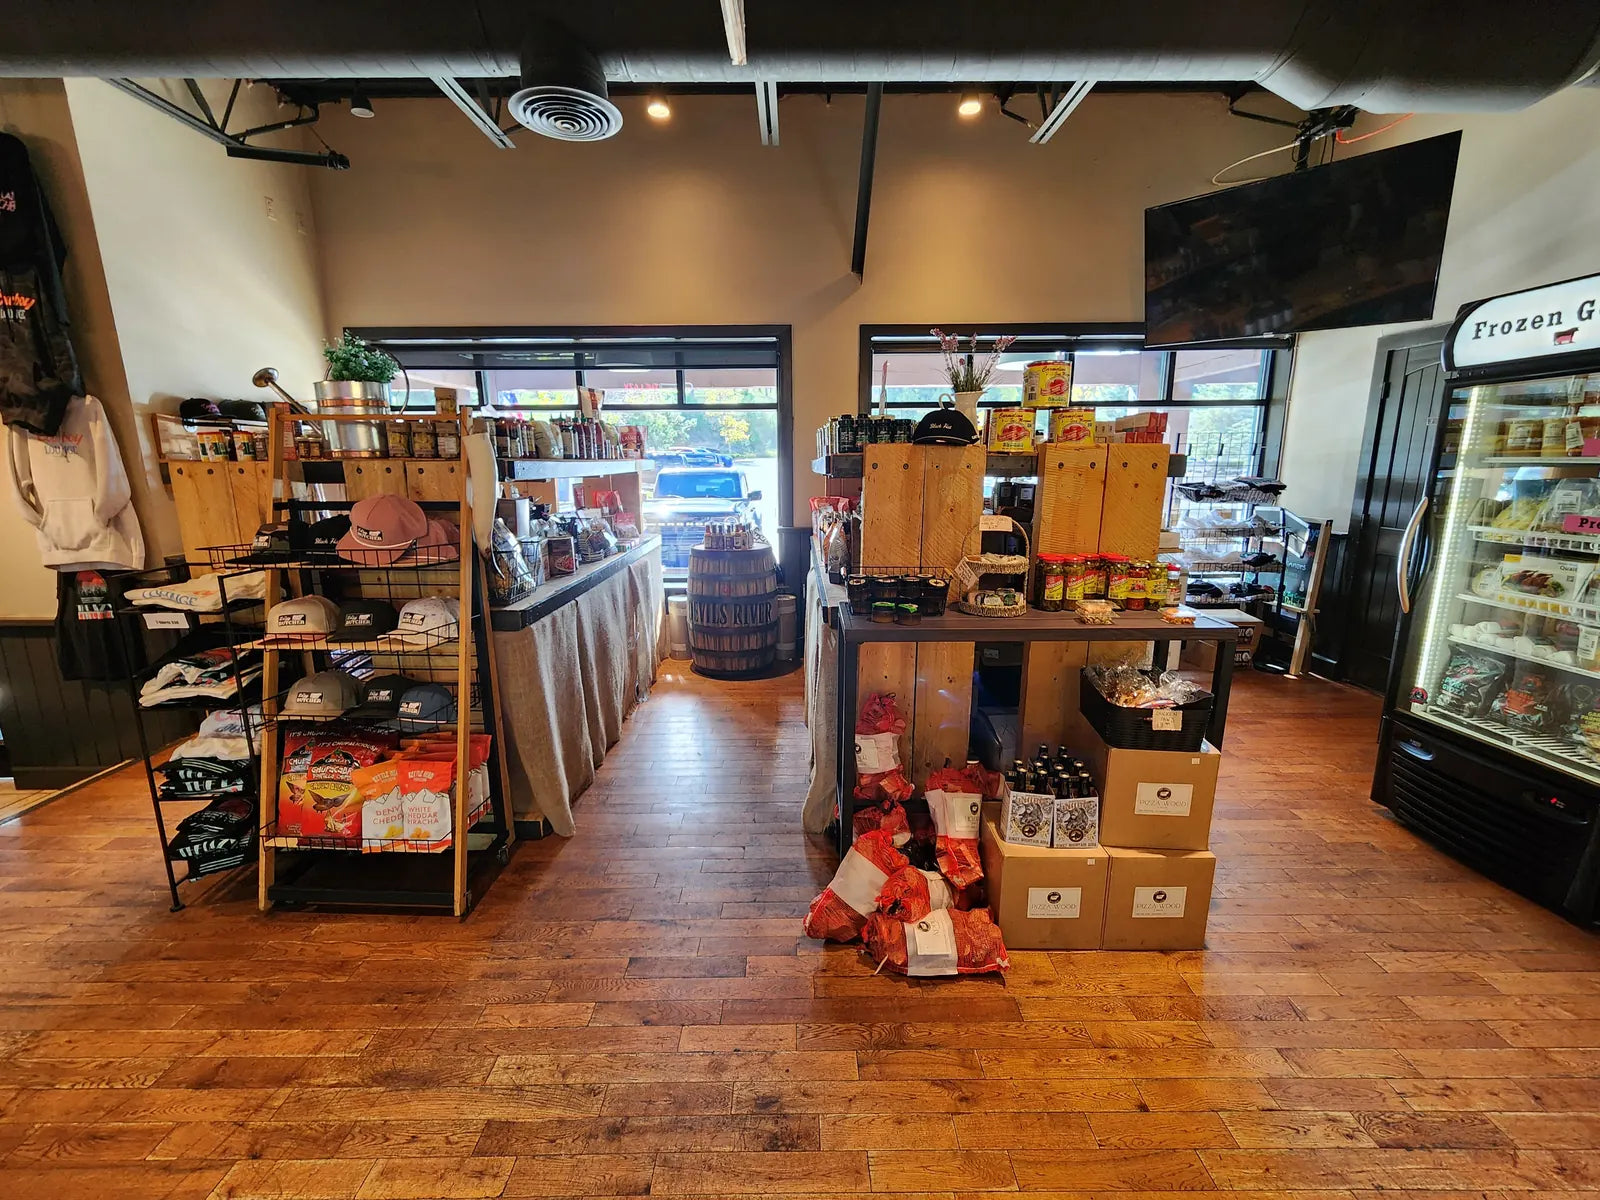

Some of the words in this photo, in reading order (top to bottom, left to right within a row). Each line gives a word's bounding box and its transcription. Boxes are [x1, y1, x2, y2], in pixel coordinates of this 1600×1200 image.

[1472, 311, 1562, 340] Frozen
[690, 600, 728, 625] DEVILS
[733, 601, 772, 625] RIVER
[407, 812, 439, 820] HEDDAR
